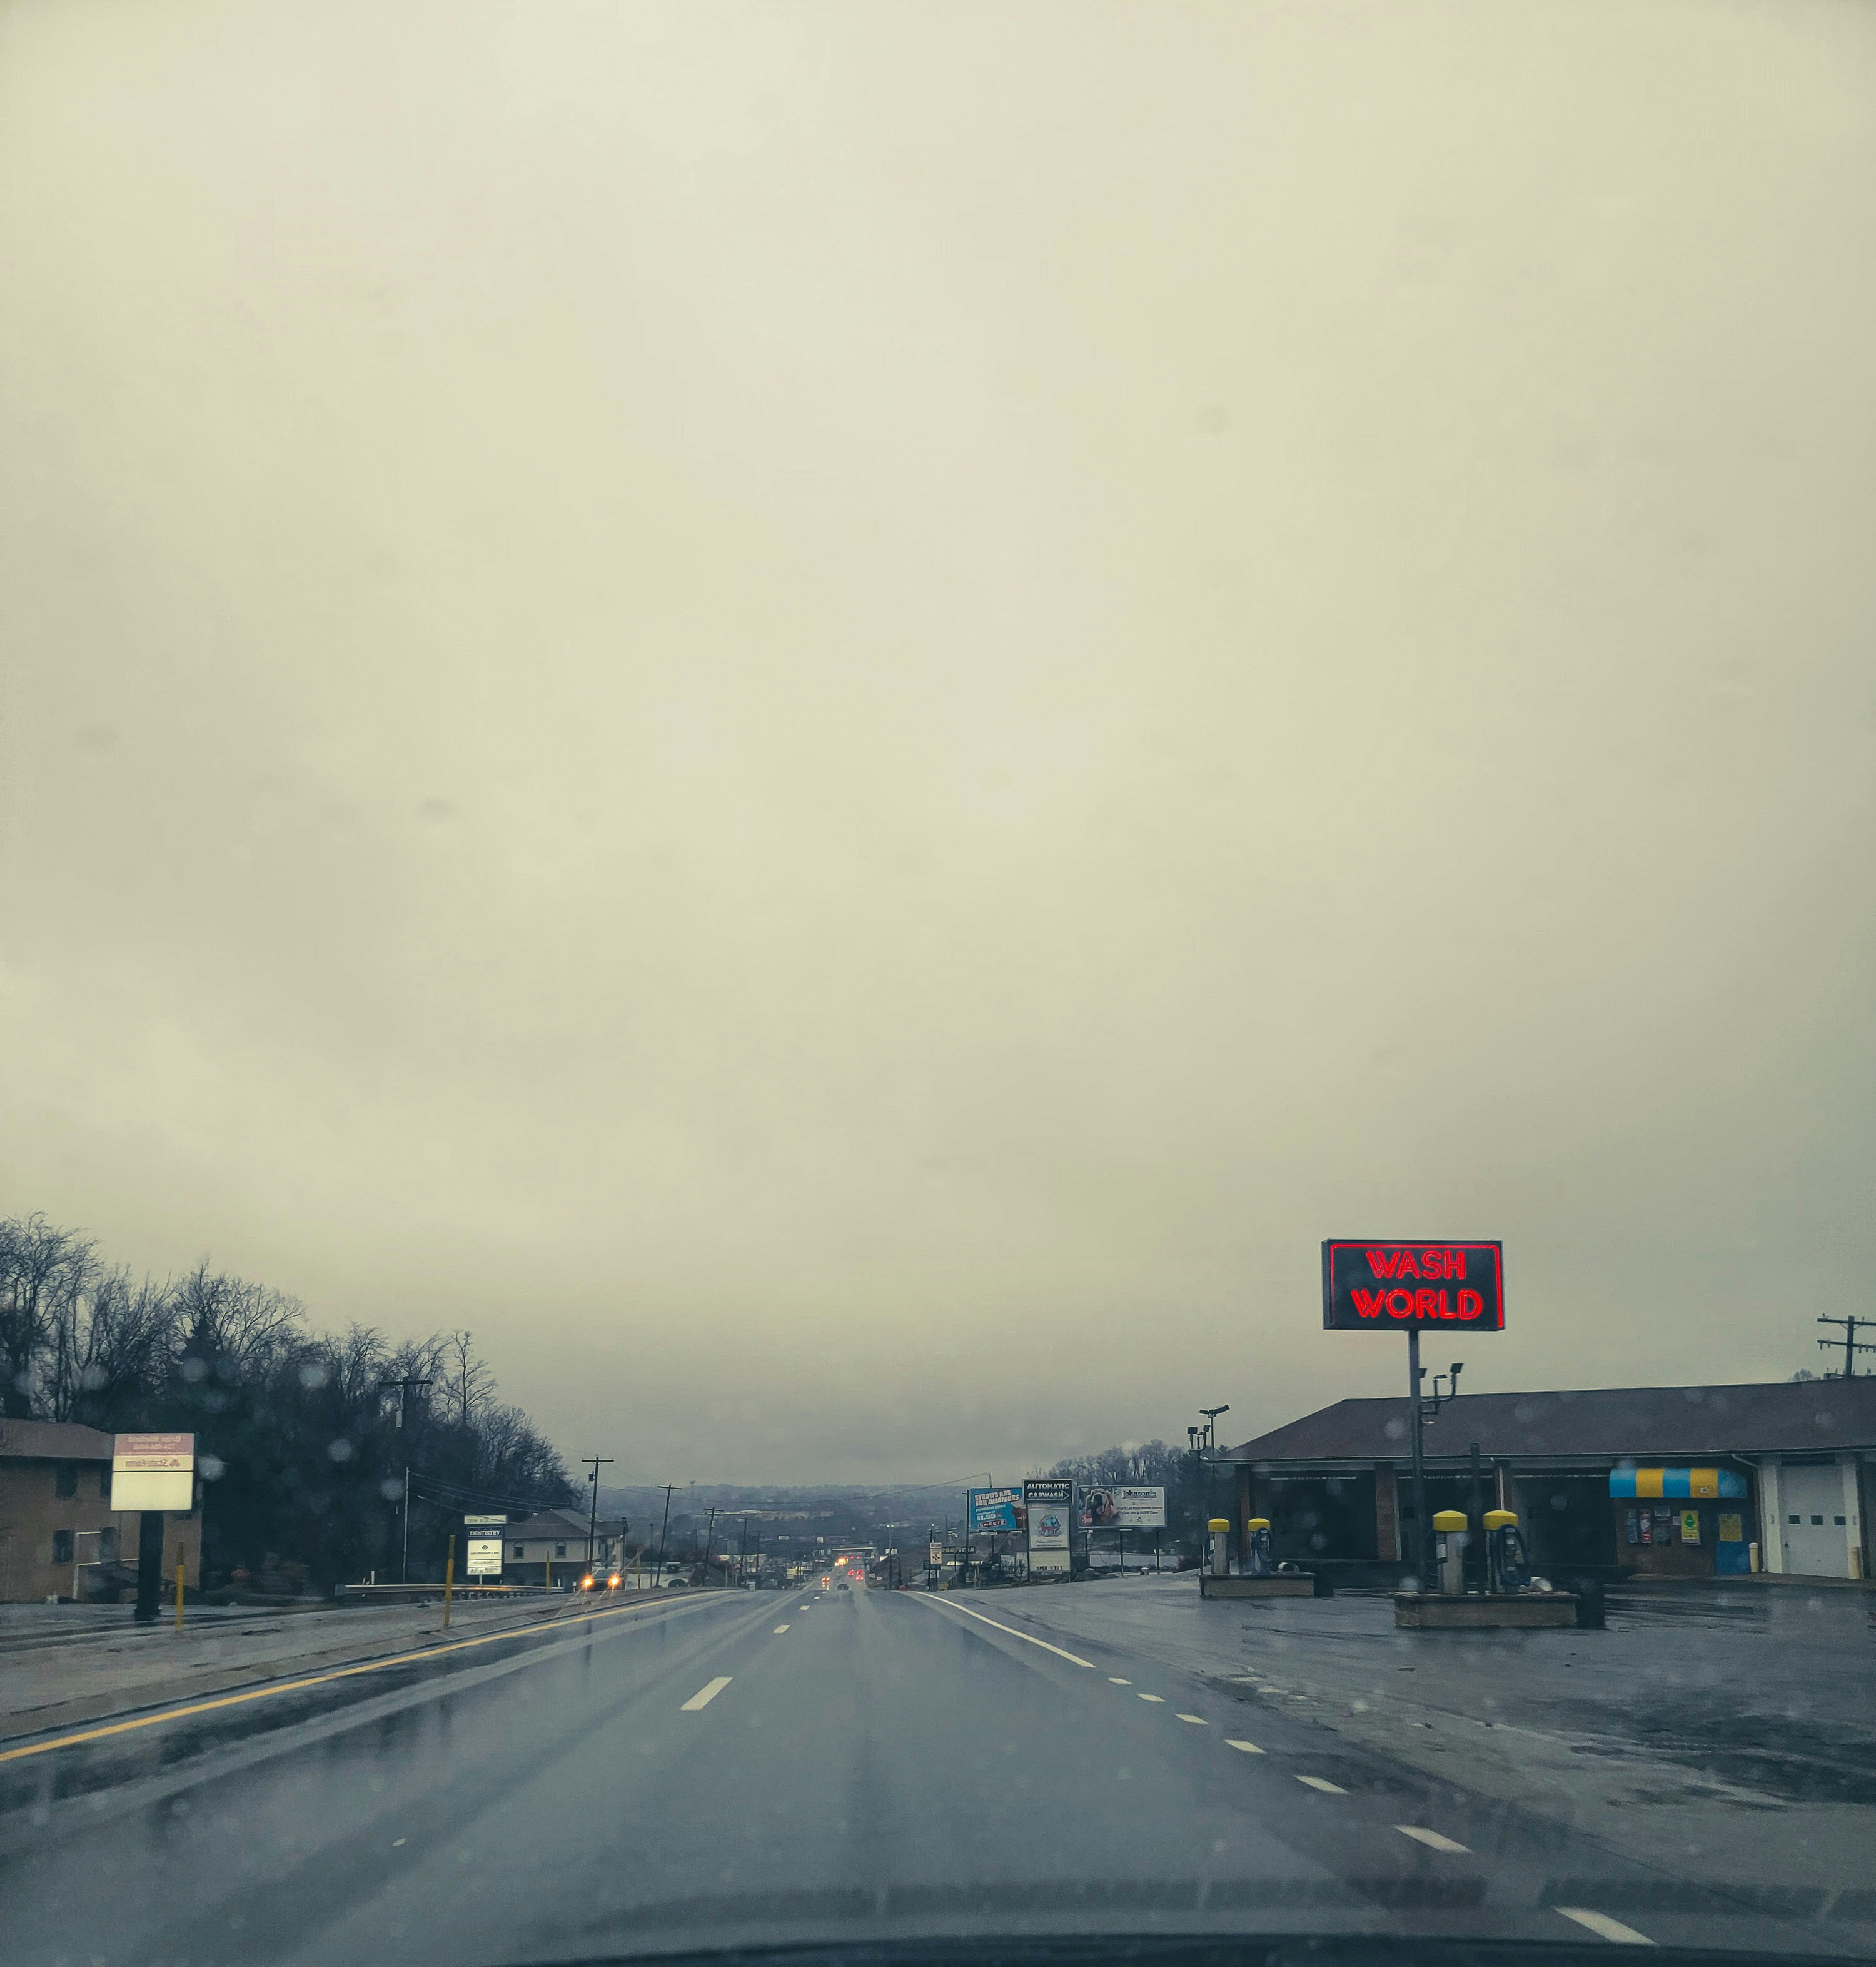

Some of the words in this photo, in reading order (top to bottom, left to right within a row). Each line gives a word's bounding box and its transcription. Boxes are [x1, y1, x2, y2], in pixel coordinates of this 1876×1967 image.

[1366, 1251, 1466, 1280] WASH
[1351, 1289, 1483, 1320] WORLD
[975, 1492, 999, 1500] STRAWS
[988, 1494, 1020, 1505] AMATEURS
